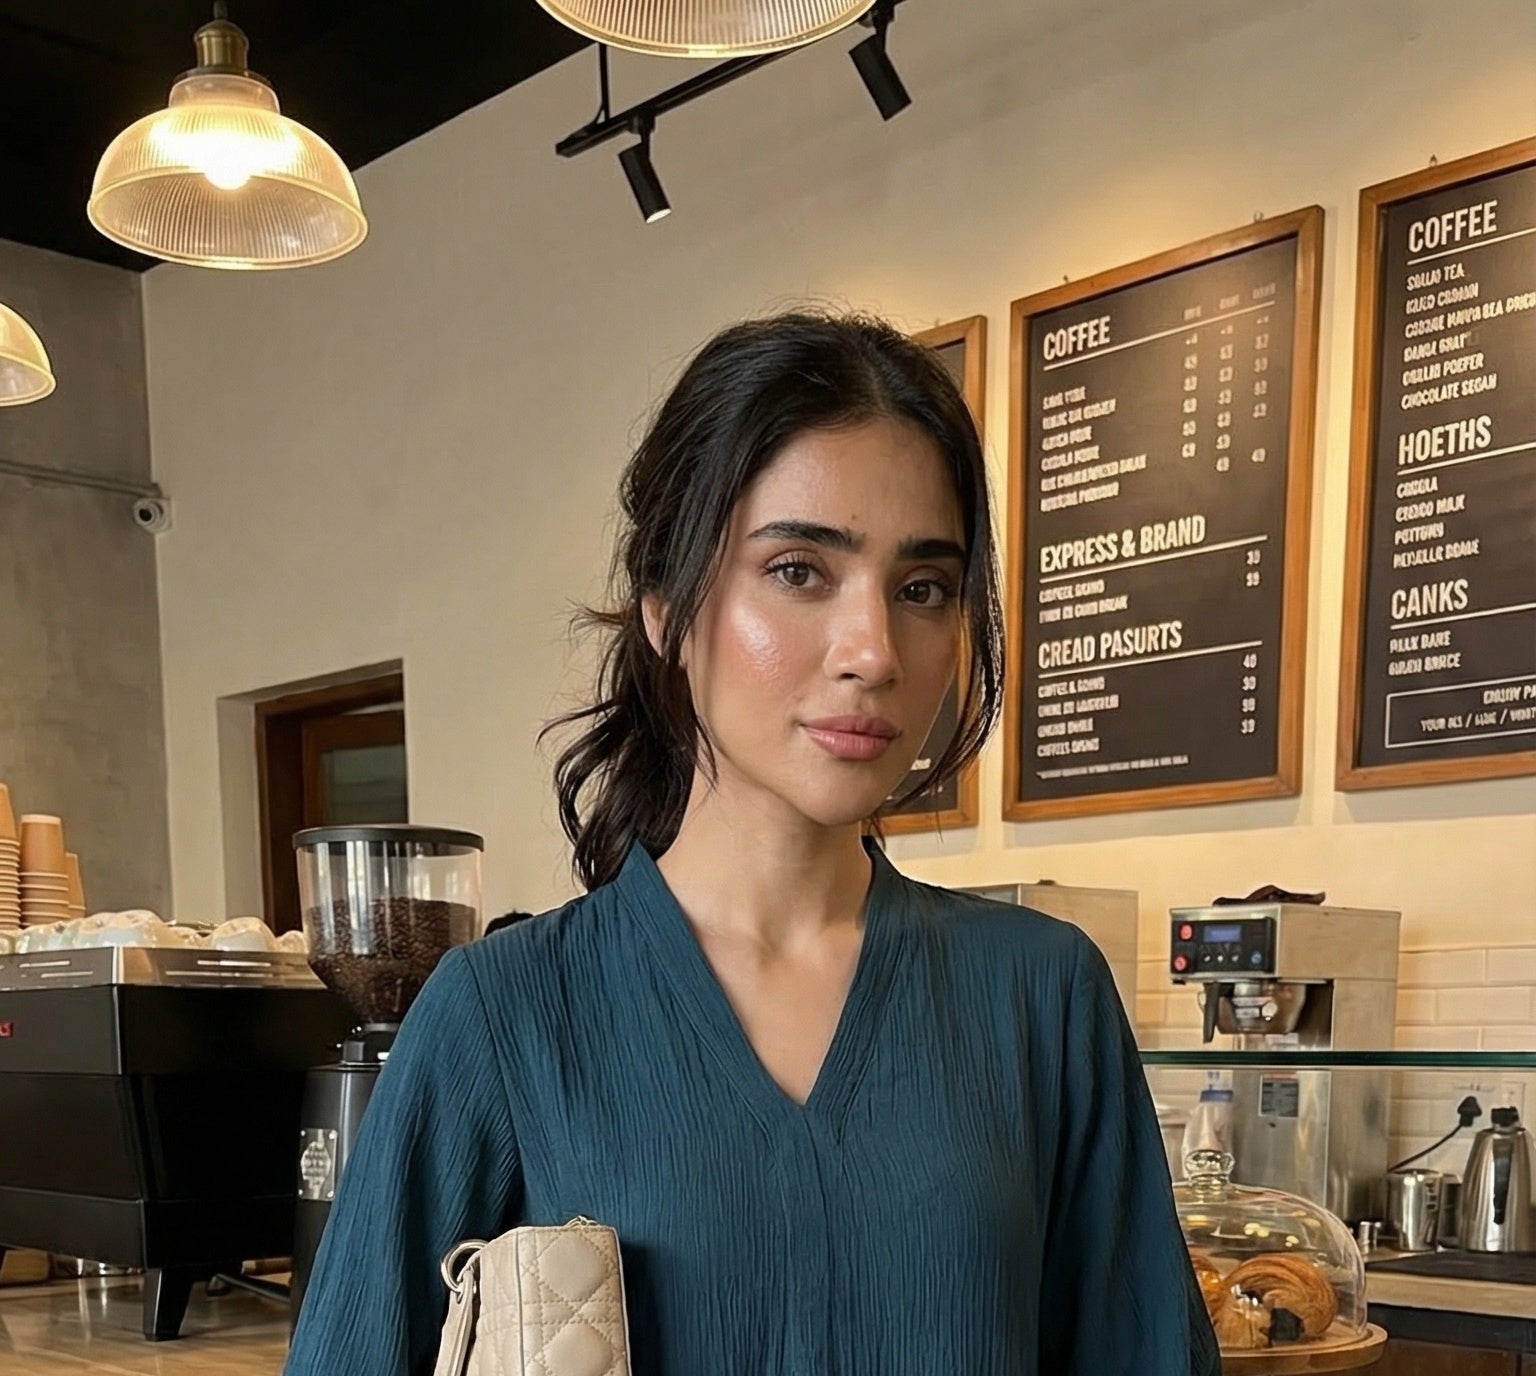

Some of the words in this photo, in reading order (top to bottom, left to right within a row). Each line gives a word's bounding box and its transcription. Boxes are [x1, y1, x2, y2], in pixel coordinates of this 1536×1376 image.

[1408, 200, 1498, 253] COFFEE
[1444, 262, 1465, 281] TEA
[1043, 315, 1111, 361] COFFEE
[1401, 381, 1460, 410] CHOCOLATE
[1397, 415, 1493, 467] HOETHS
[1040, 533, 1118, 573] EXPRESS
[1120, 528, 1136, 558] &
[1140, 514, 1207, 555] BRAND
[1390, 578, 1469, 621] CANKS
[1038, 635, 1096, 669] CREAD
[1099, 620, 1184, 660] PASURTS
